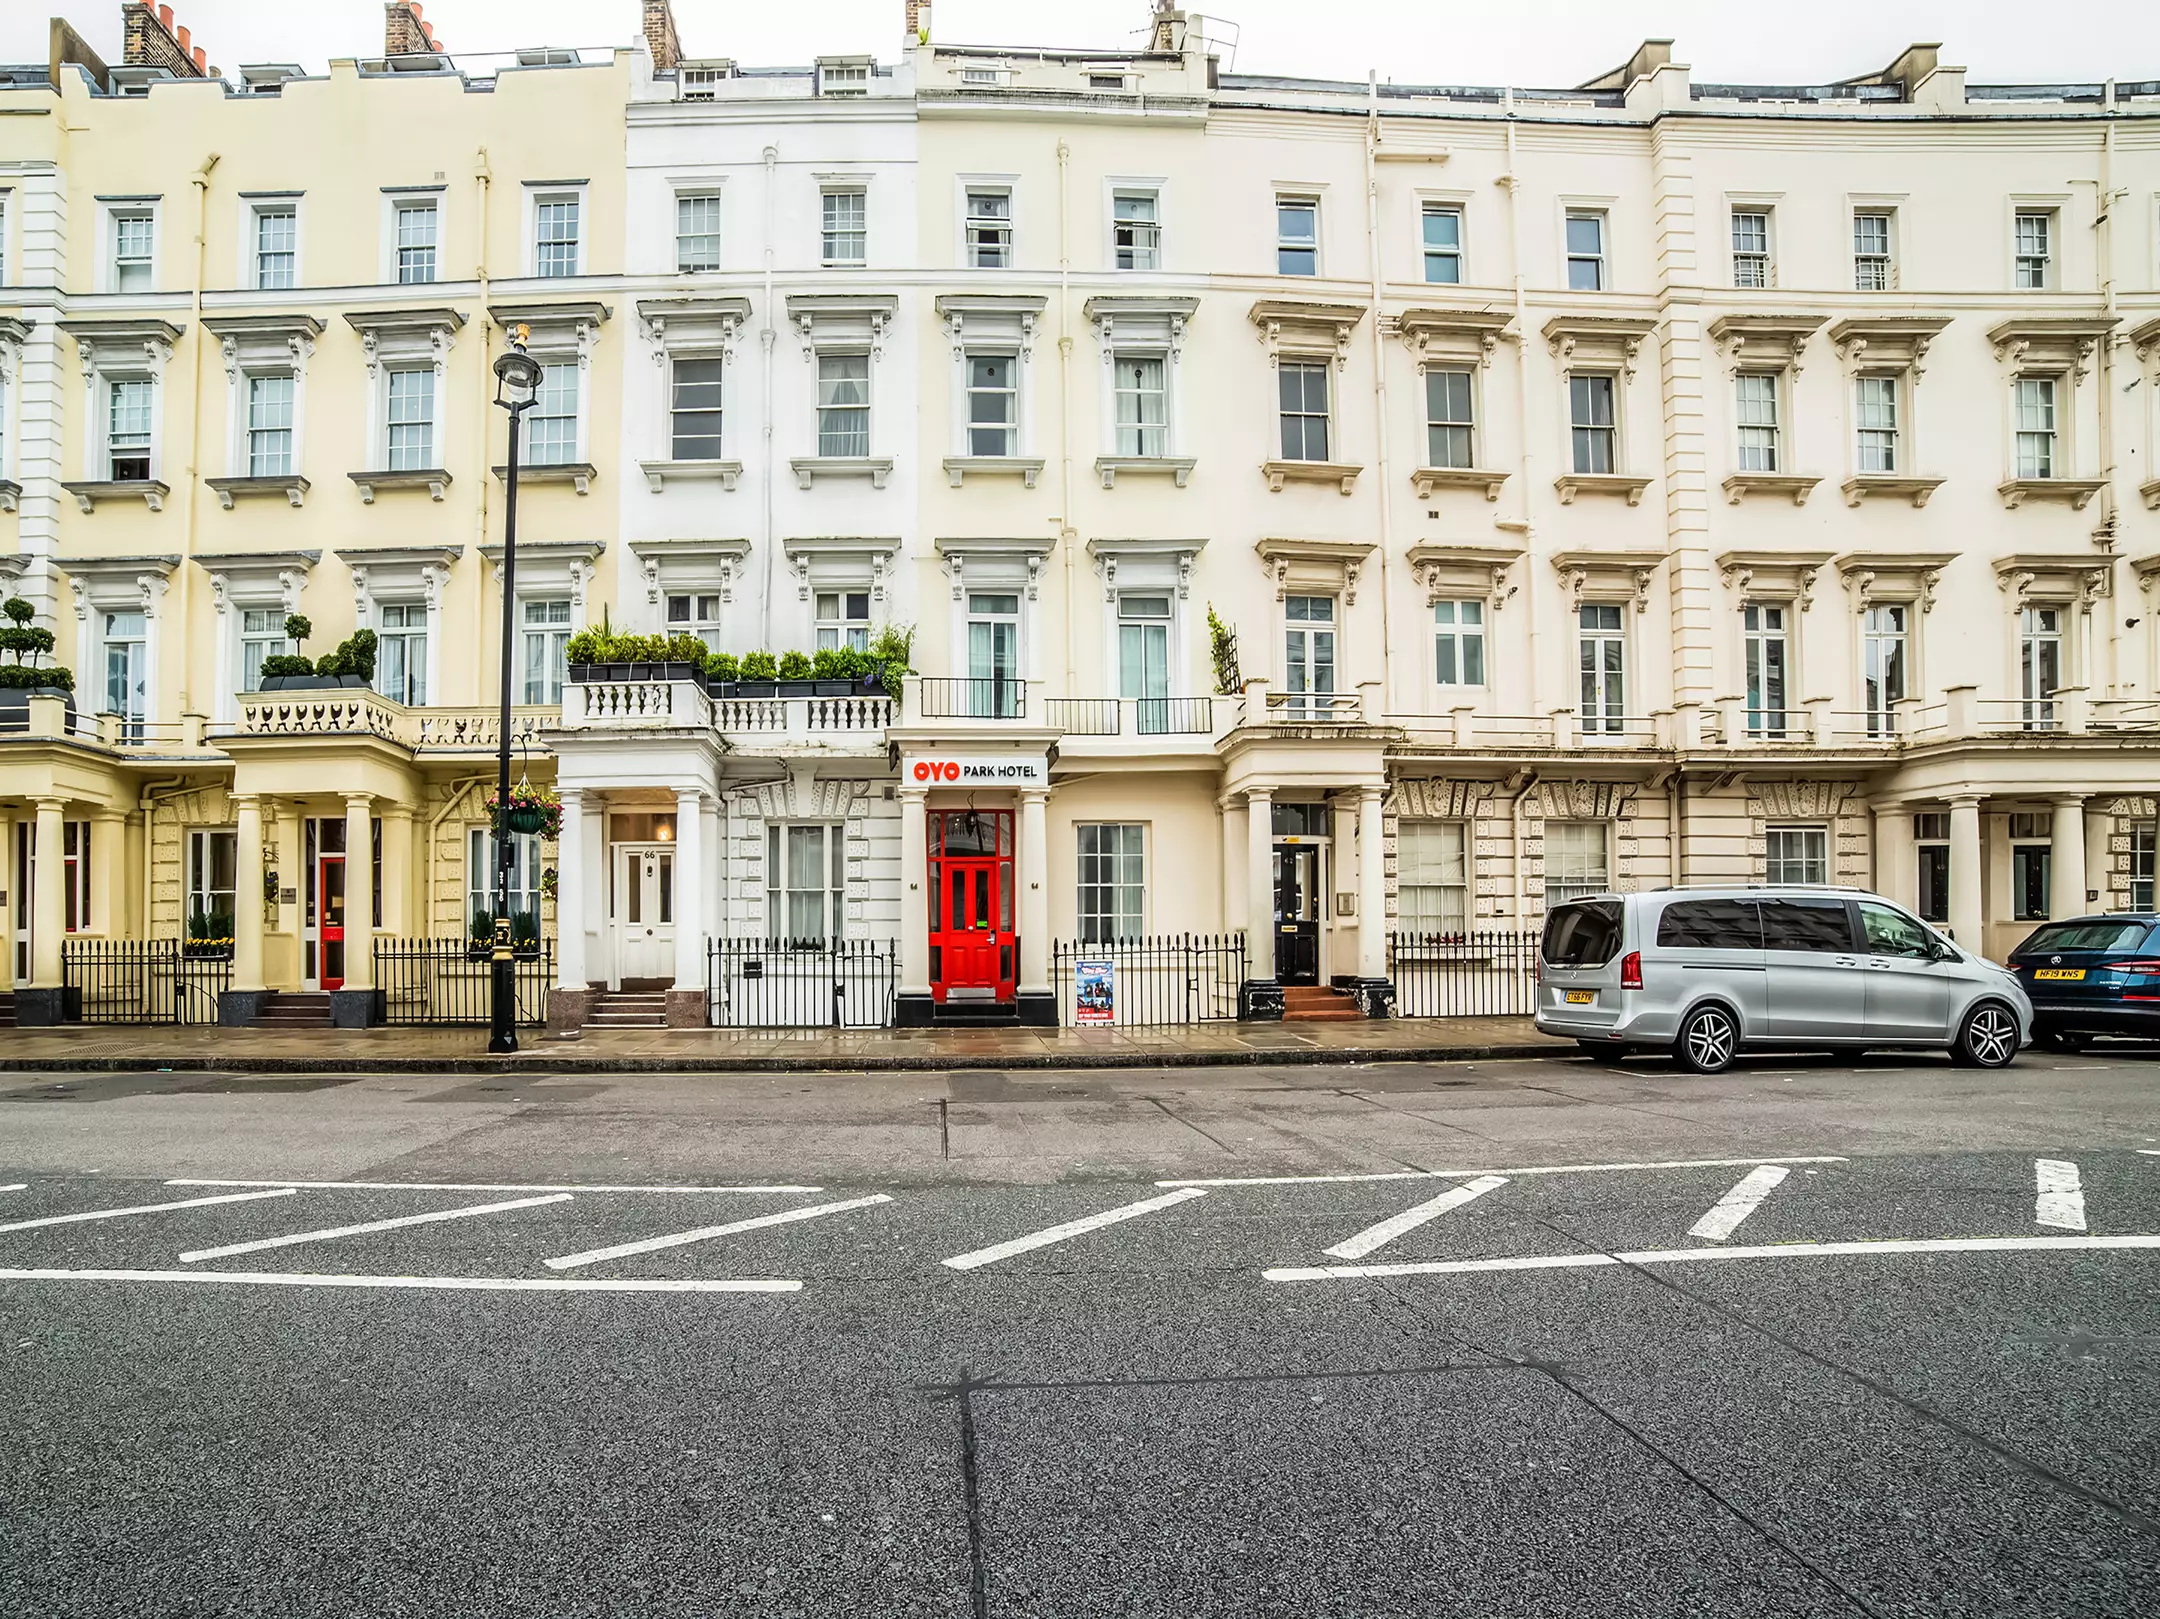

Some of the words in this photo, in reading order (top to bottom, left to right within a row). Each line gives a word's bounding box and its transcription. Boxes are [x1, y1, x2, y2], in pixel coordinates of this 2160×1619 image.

[913, 761, 960, 781] OYO
[963, 765, 995, 777] PARK
[998, 765, 1038, 777] HOTEL
[644, 850, 655, 859] 66
